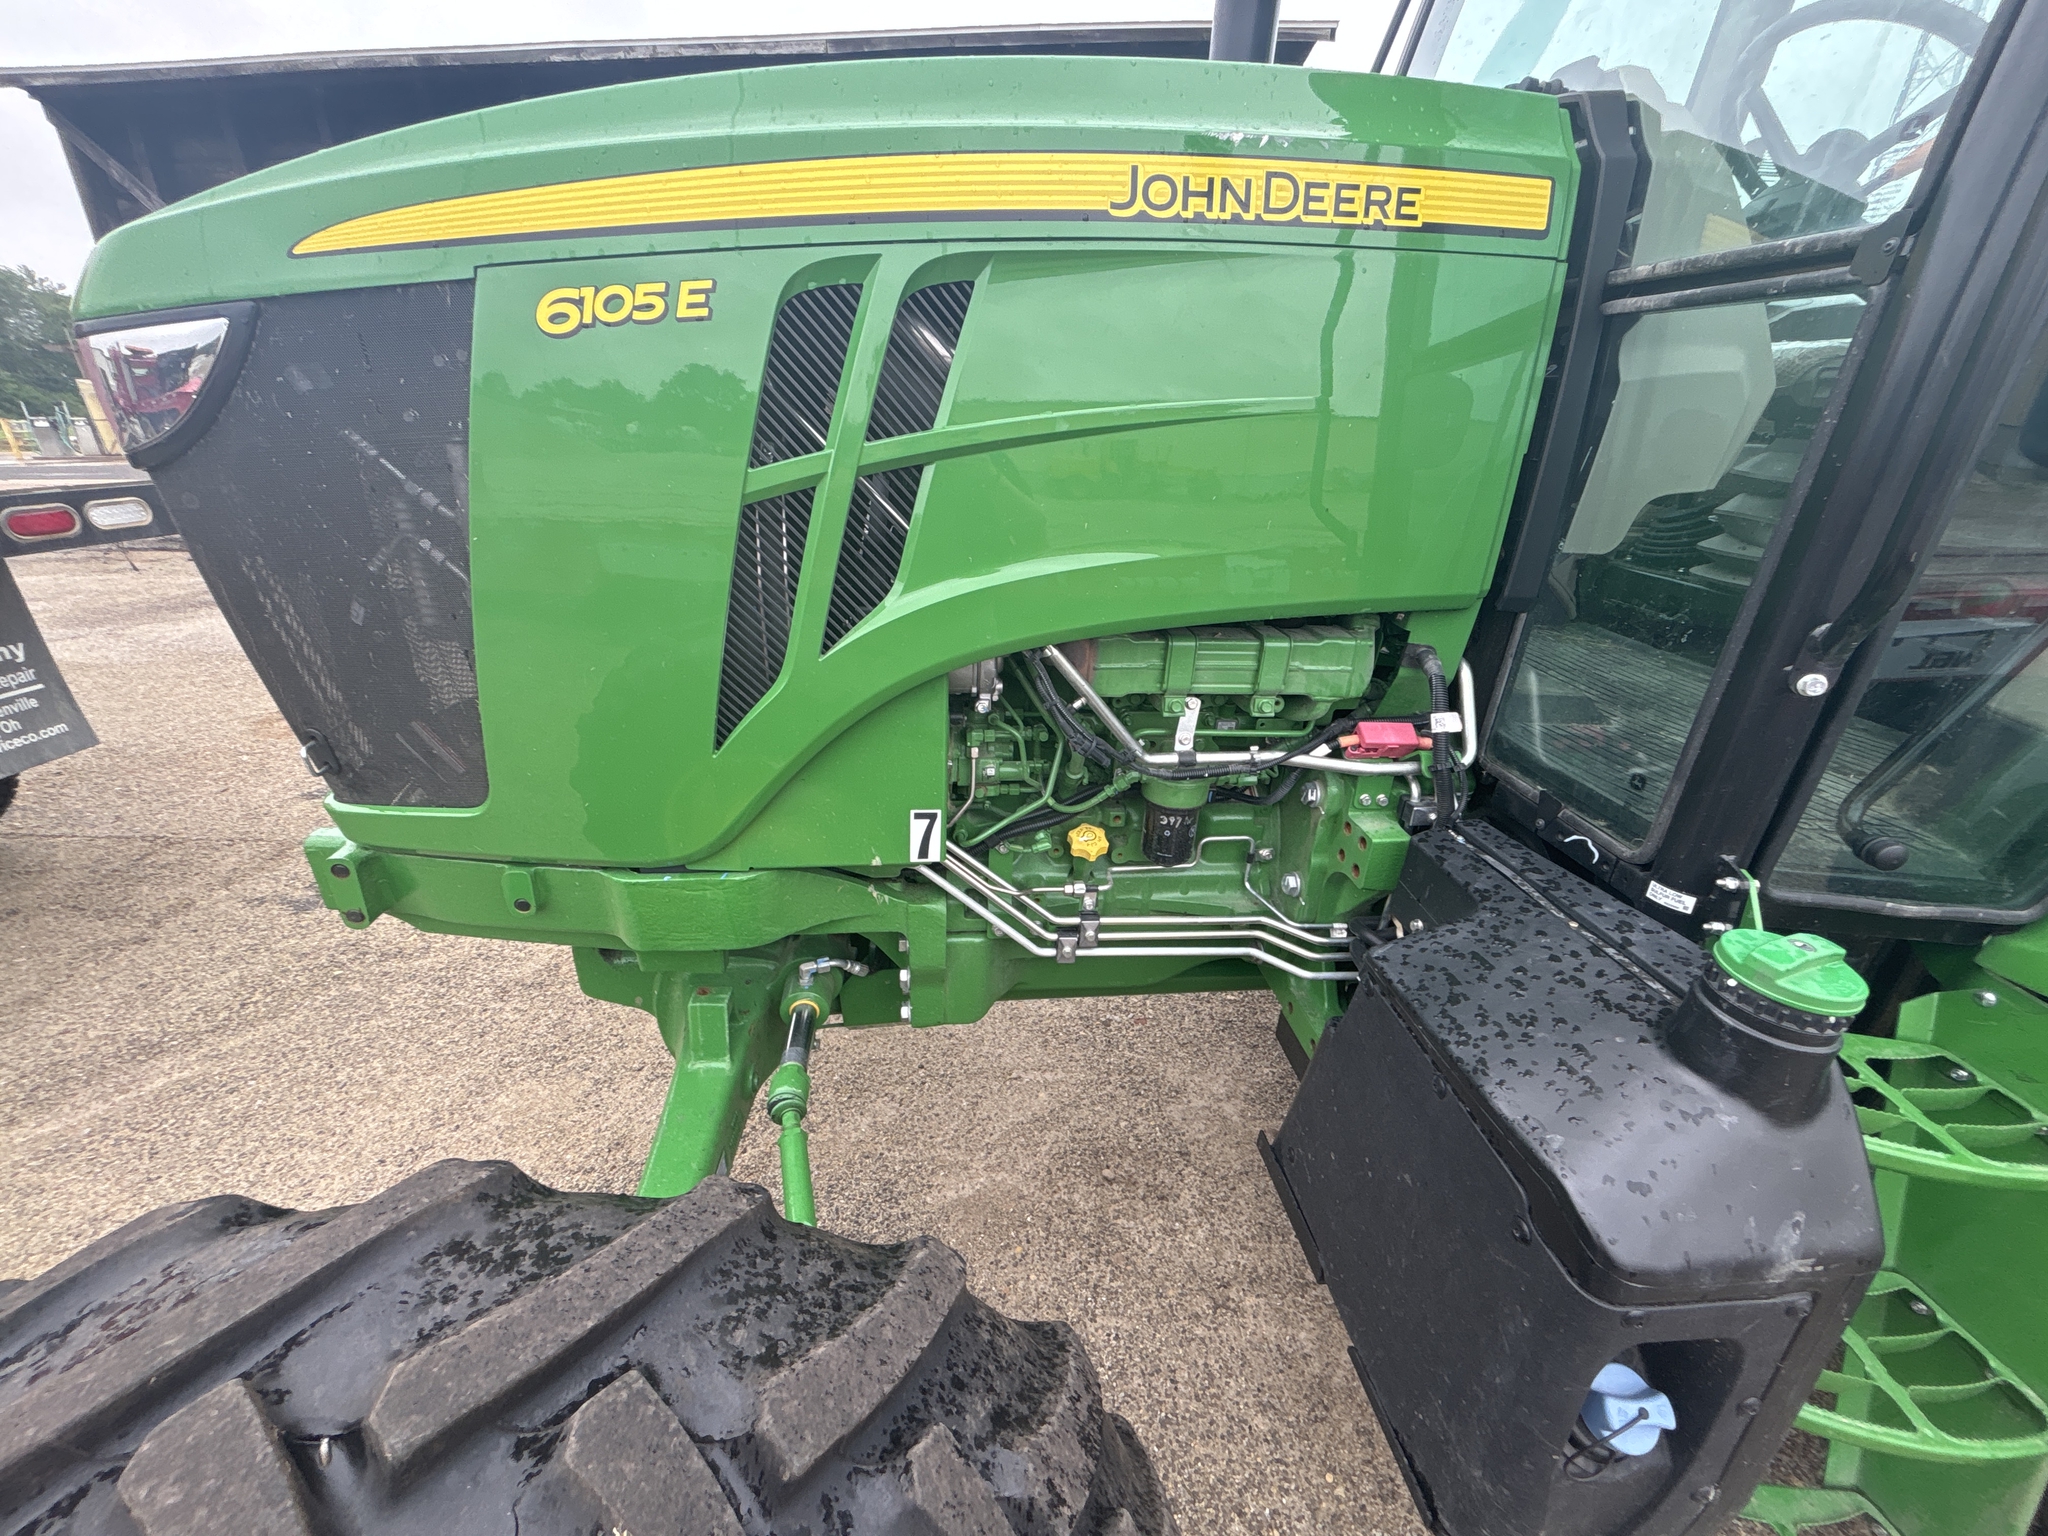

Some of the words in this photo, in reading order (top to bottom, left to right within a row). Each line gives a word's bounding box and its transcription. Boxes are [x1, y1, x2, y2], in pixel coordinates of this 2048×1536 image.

[1108, 163, 1255, 217] JOHN
[1263, 170, 1423, 222] DEERE
[0, 666, 37, 690] epair
[913, 812, 938, 860] 7
